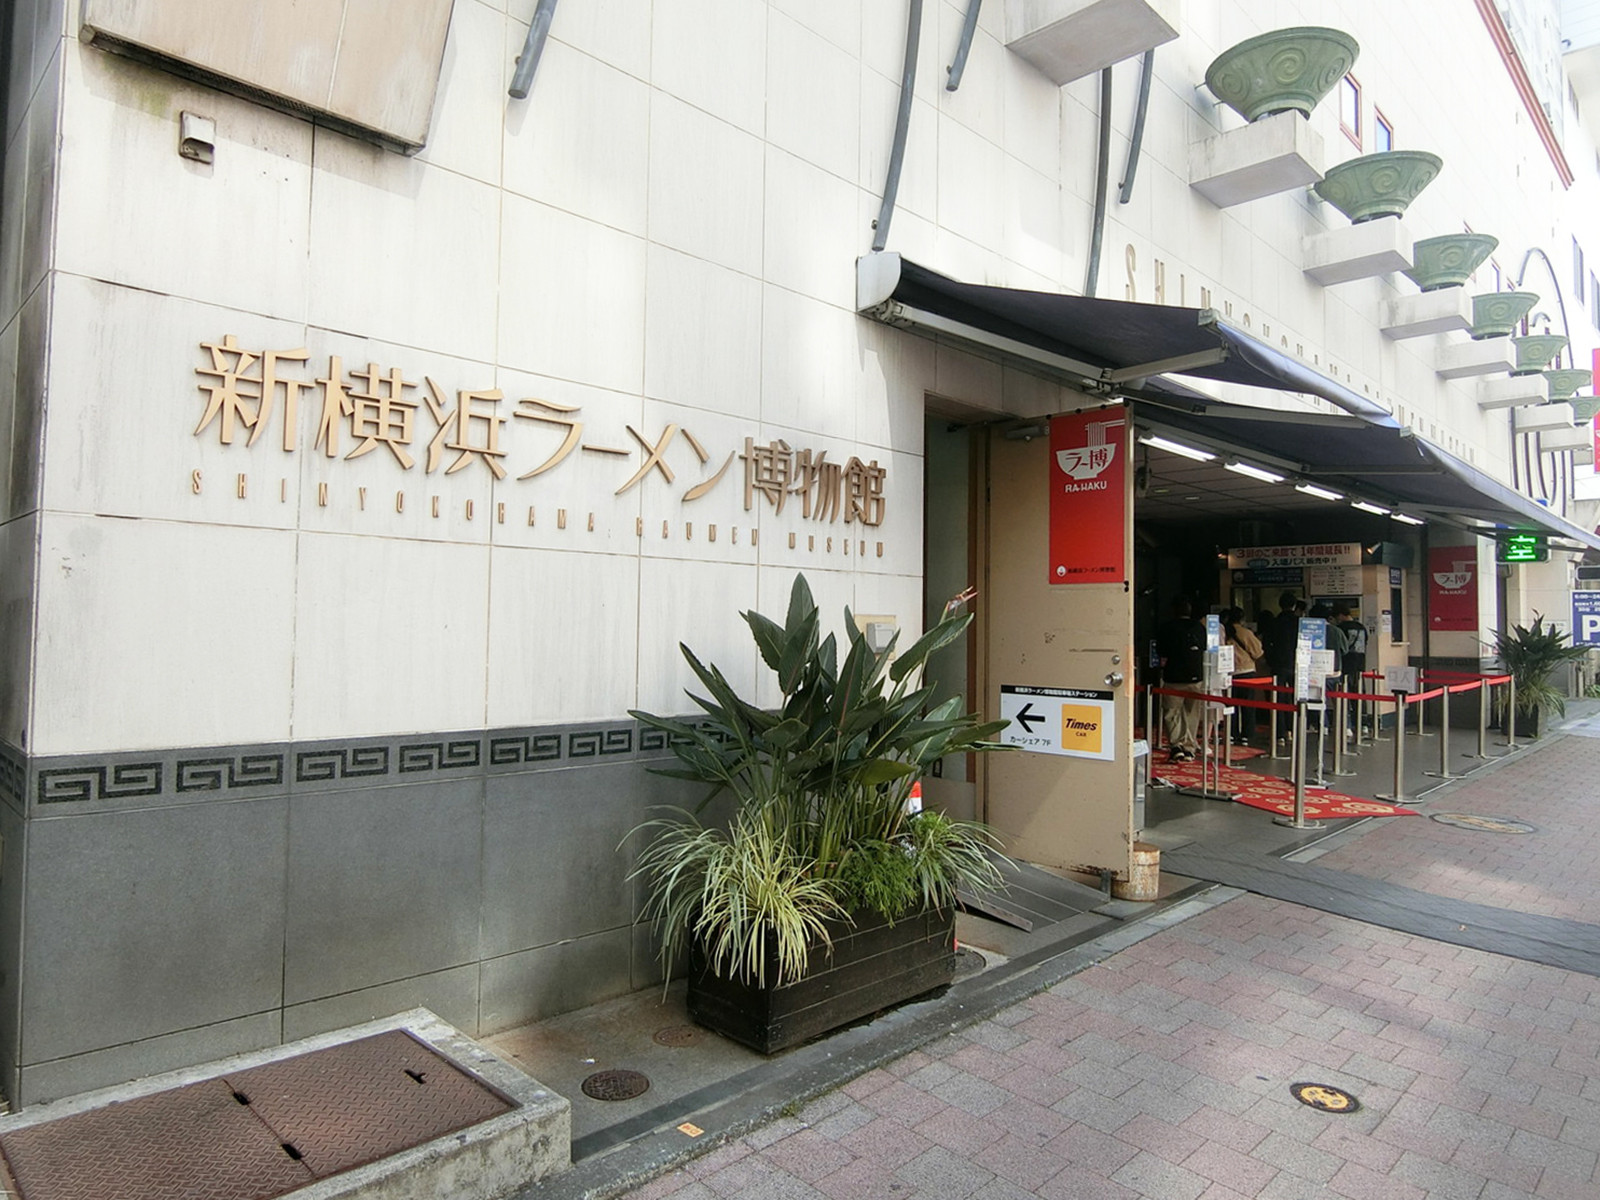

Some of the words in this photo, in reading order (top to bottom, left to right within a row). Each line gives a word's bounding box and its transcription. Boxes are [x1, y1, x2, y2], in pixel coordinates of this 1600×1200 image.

[194, 334, 886, 527] 新横浜ラーメン博物館
[192, 469, 595, 532] SHINYOKOHAMA
[636, 516, 758, 546] RAUMEN
[788, 531, 884, 558] MUSEUM
[1010, 736, 1040, 746] カーシェア
[1065, 718, 1098, 731] Times
